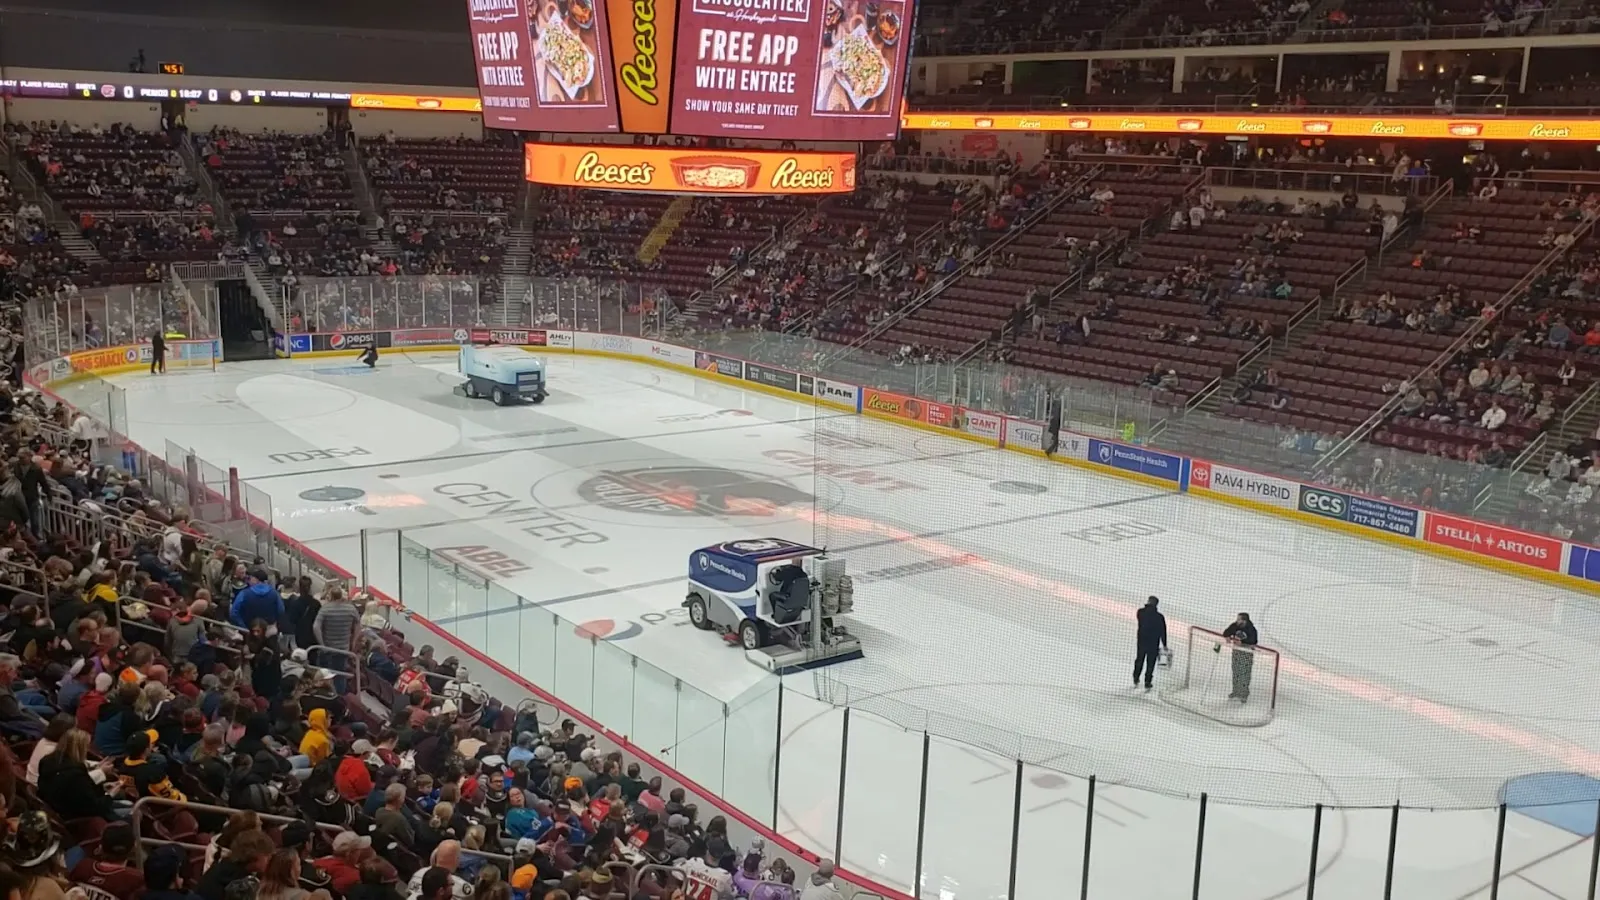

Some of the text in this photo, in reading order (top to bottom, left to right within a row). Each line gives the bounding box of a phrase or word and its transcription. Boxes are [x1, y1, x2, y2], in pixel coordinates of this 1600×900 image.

[477, 31, 519, 60] FREE APP
[619, 0, 658, 105] Reese
[698, 28, 799, 67] FREE APP
[482, 66, 524, 86] WITH ENTREE
[695, 65, 796, 93] WITH ENTREE
[123, 86, 134, 98] 0
[208, 89, 218, 101] 0
[685, 98, 799, 116] SHOW YOUR SAME DAY TICKET
[1529, 124, 1571, 138] Reese's
[574, 151, 655, 185] Reese's
[770, 157, 834, 188] Reese's
[346, 333, 374, 345] pepsi
[827, 386, 853, 399] RAM
[970, 417, 997, 430] GIANT
[1146, 455, 1168, 468] Health
[1214, 472, 1291, 501] RAV4 HYBRID
[1304, 492, 1343, 514] ecs
[1352, 498, 1414, 517] Distribution Support
[433, 482, 609, 548] CENTER
[1350, 505, 1414, 526] Commercial Cleaning
[1353, 513, 1410, 534] 717-867-4480
[1435, 524, 1548, 560] STELLA ARTOIS
[447, 545, 534, 579] ABEL
